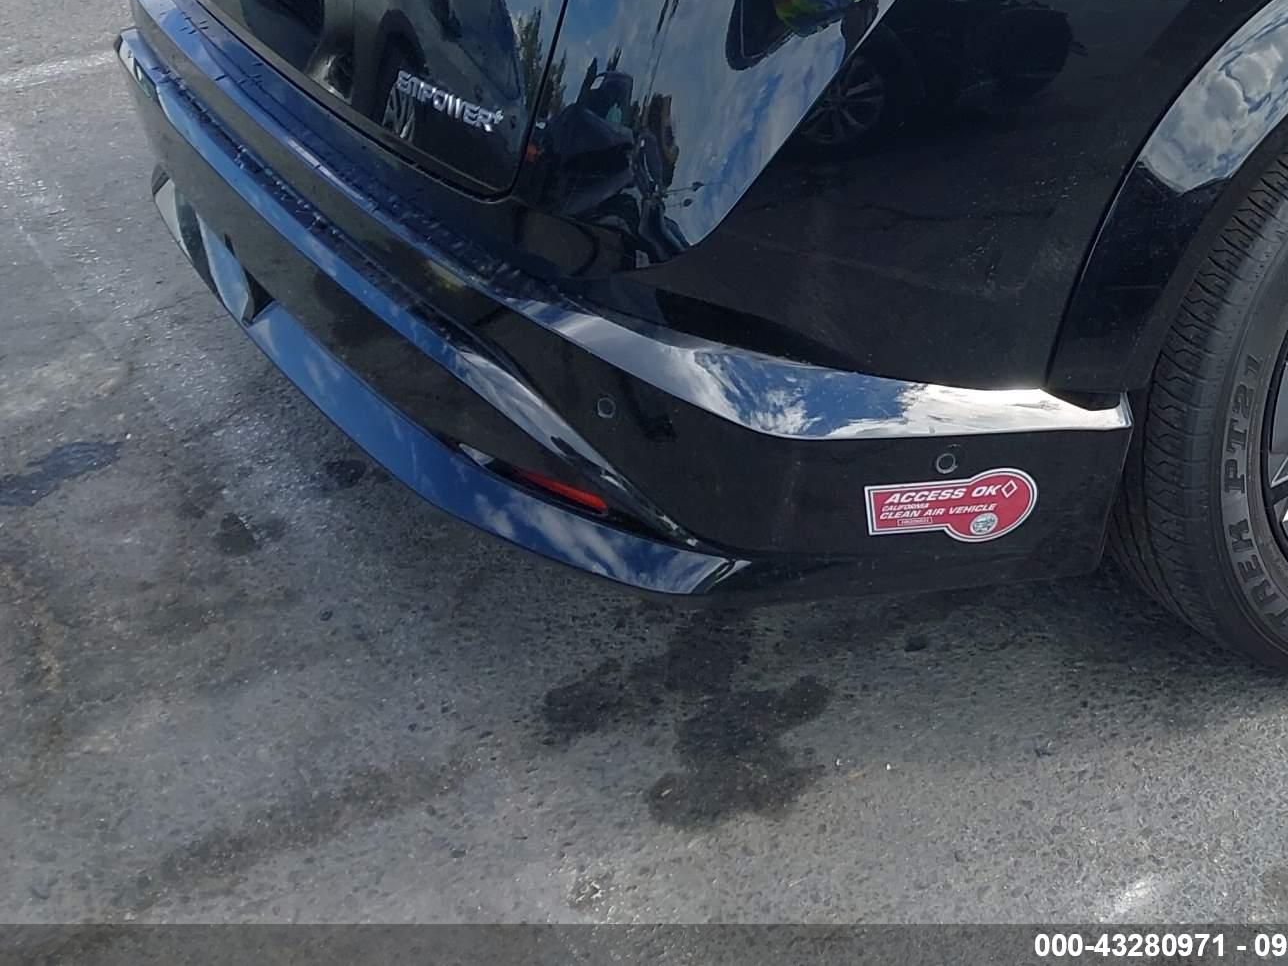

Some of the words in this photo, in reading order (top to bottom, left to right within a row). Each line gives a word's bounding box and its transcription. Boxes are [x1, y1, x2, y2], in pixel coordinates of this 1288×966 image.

[1224, 353, 1263, 494] PT21
[884, 488, 967, 504] ACCESS
[971, 484, 1001, 498] OK
[880, 510, 924, 520] CLEAN
[925, 508, 945, 517] AIR
[950, 503, 998, 514] VEHICLE
[881, 502, 930, 512] CALIFORNIA
